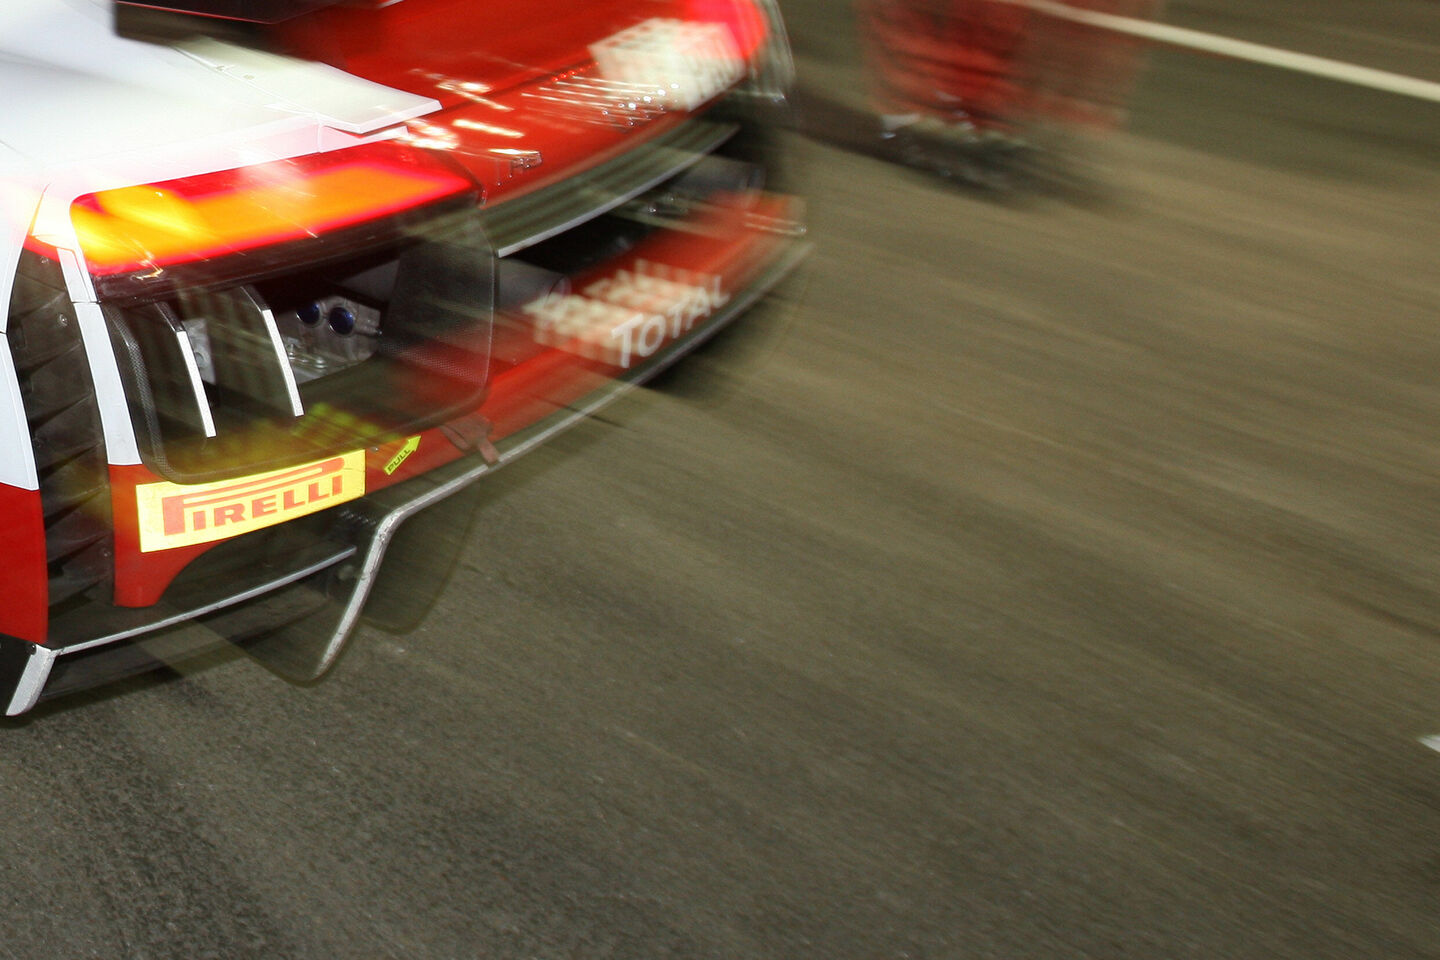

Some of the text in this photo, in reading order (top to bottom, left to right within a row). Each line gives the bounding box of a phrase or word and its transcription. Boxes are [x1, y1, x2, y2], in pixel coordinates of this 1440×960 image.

[612, 274, 730, 369] TOTAL
[161, 457, 345, 536] PIRELLI
[388, 449, 411, 472] PULL
